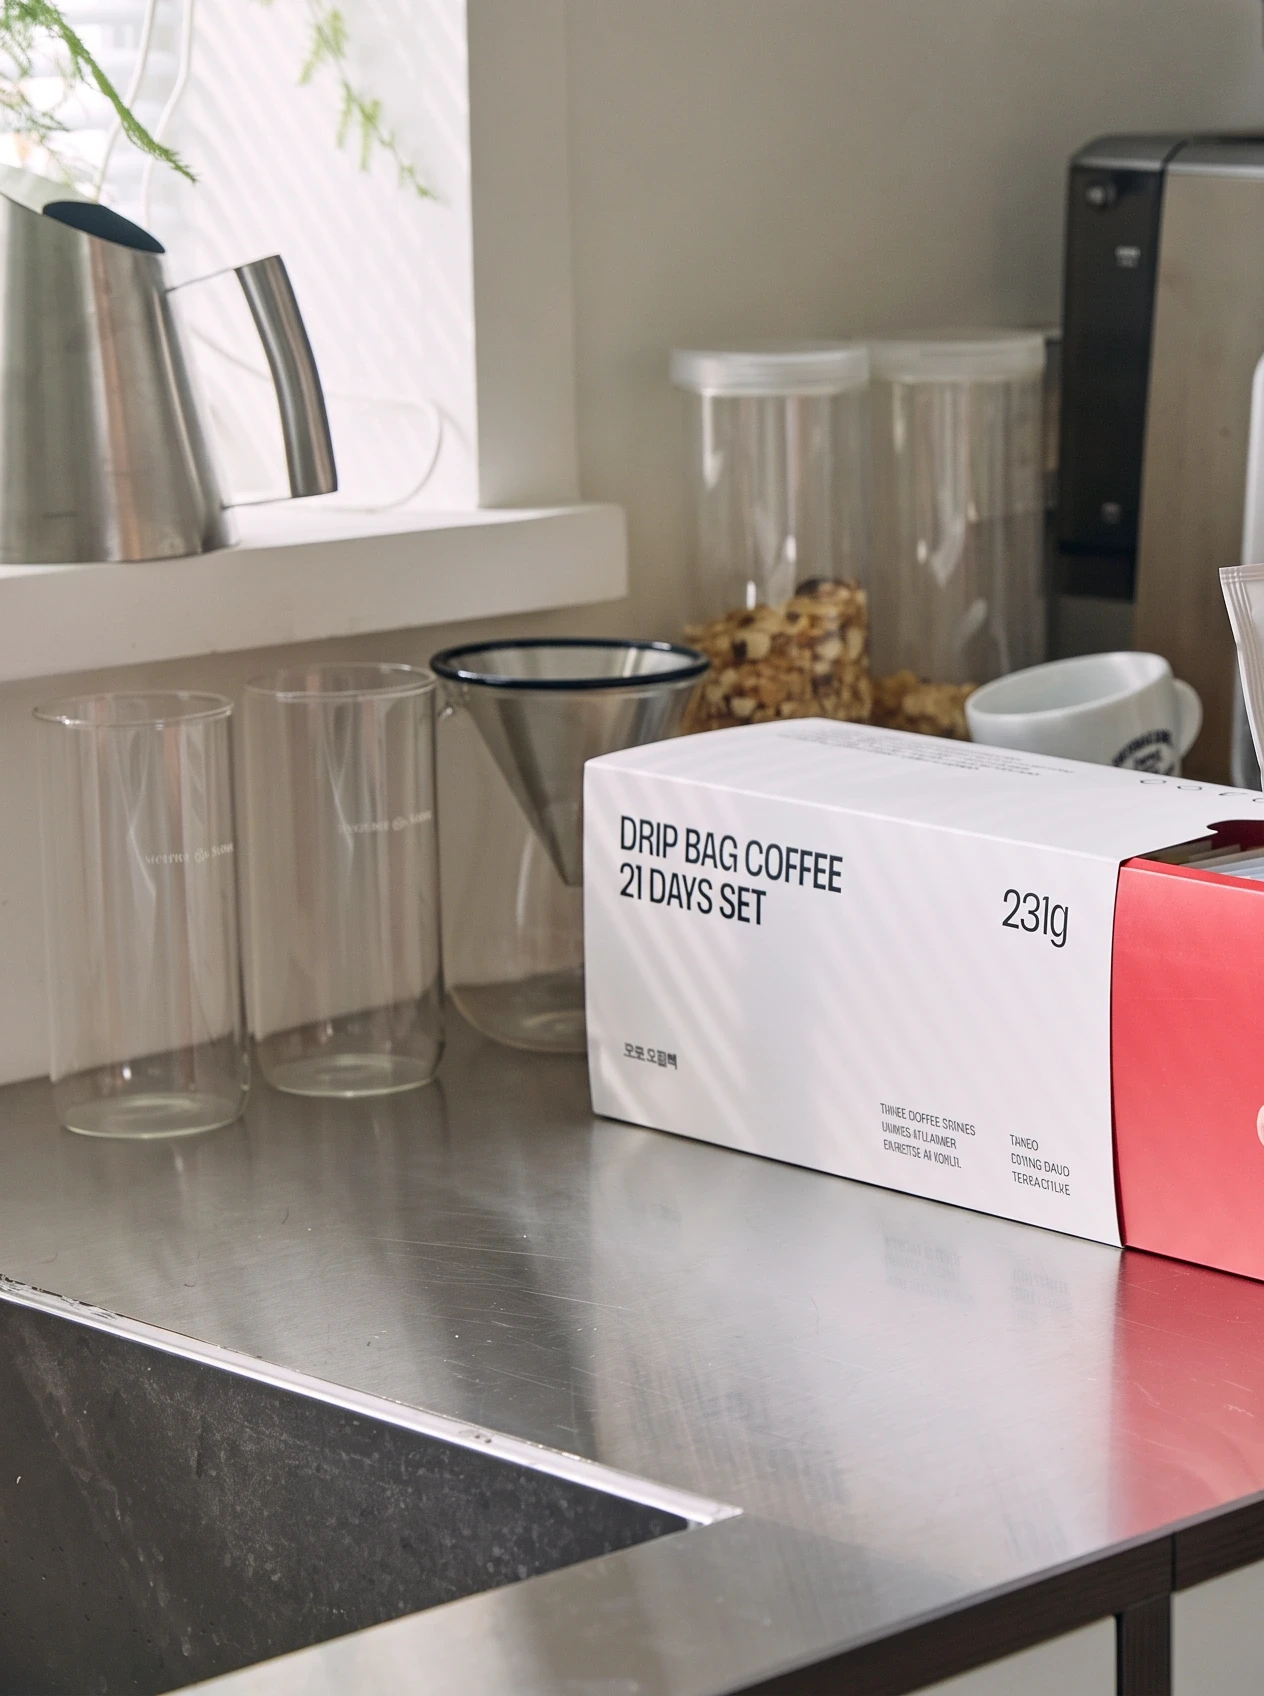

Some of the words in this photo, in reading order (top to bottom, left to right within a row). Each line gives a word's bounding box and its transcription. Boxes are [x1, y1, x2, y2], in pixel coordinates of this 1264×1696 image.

[620, 815, 679, 859] DRIP
[685, 827, 738, 873] BAG
[744, 839, 844, 894] COFFEE
[620, 862, 643, 901] 21
[649, 867, 713, 915] DAYS
[719, 882, 767, 926] SET
[1002, 888, 1069, 949] 231g
